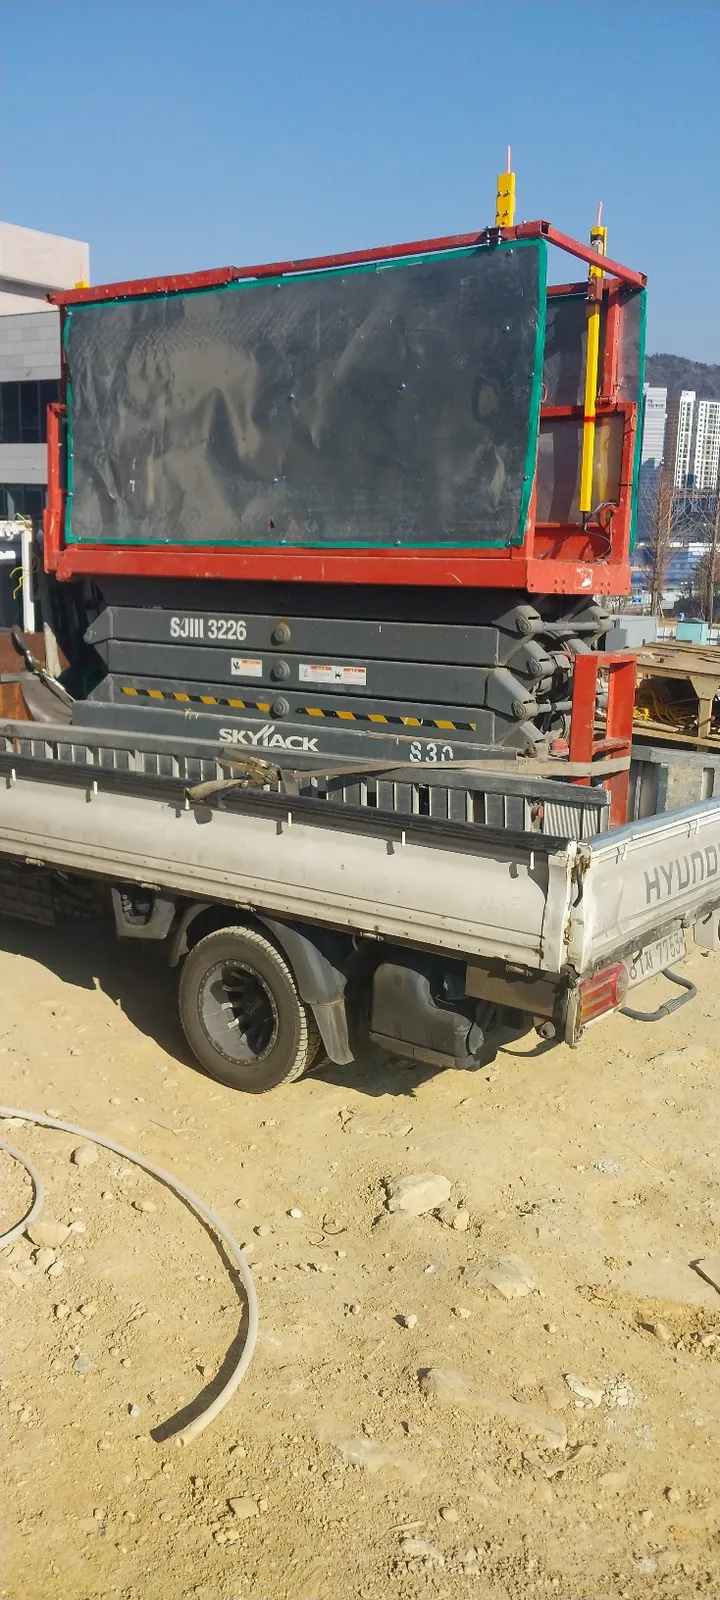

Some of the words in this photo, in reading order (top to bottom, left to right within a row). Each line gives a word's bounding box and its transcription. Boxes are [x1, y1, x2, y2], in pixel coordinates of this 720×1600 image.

[208, 619, 247, 641] 3226
[219, 724, 319, 752] SKYJACK
[410, 741, 454, 763] 830
[643, 842, 720, 904] HYUND
[656, 932, 681, 965] 7753
